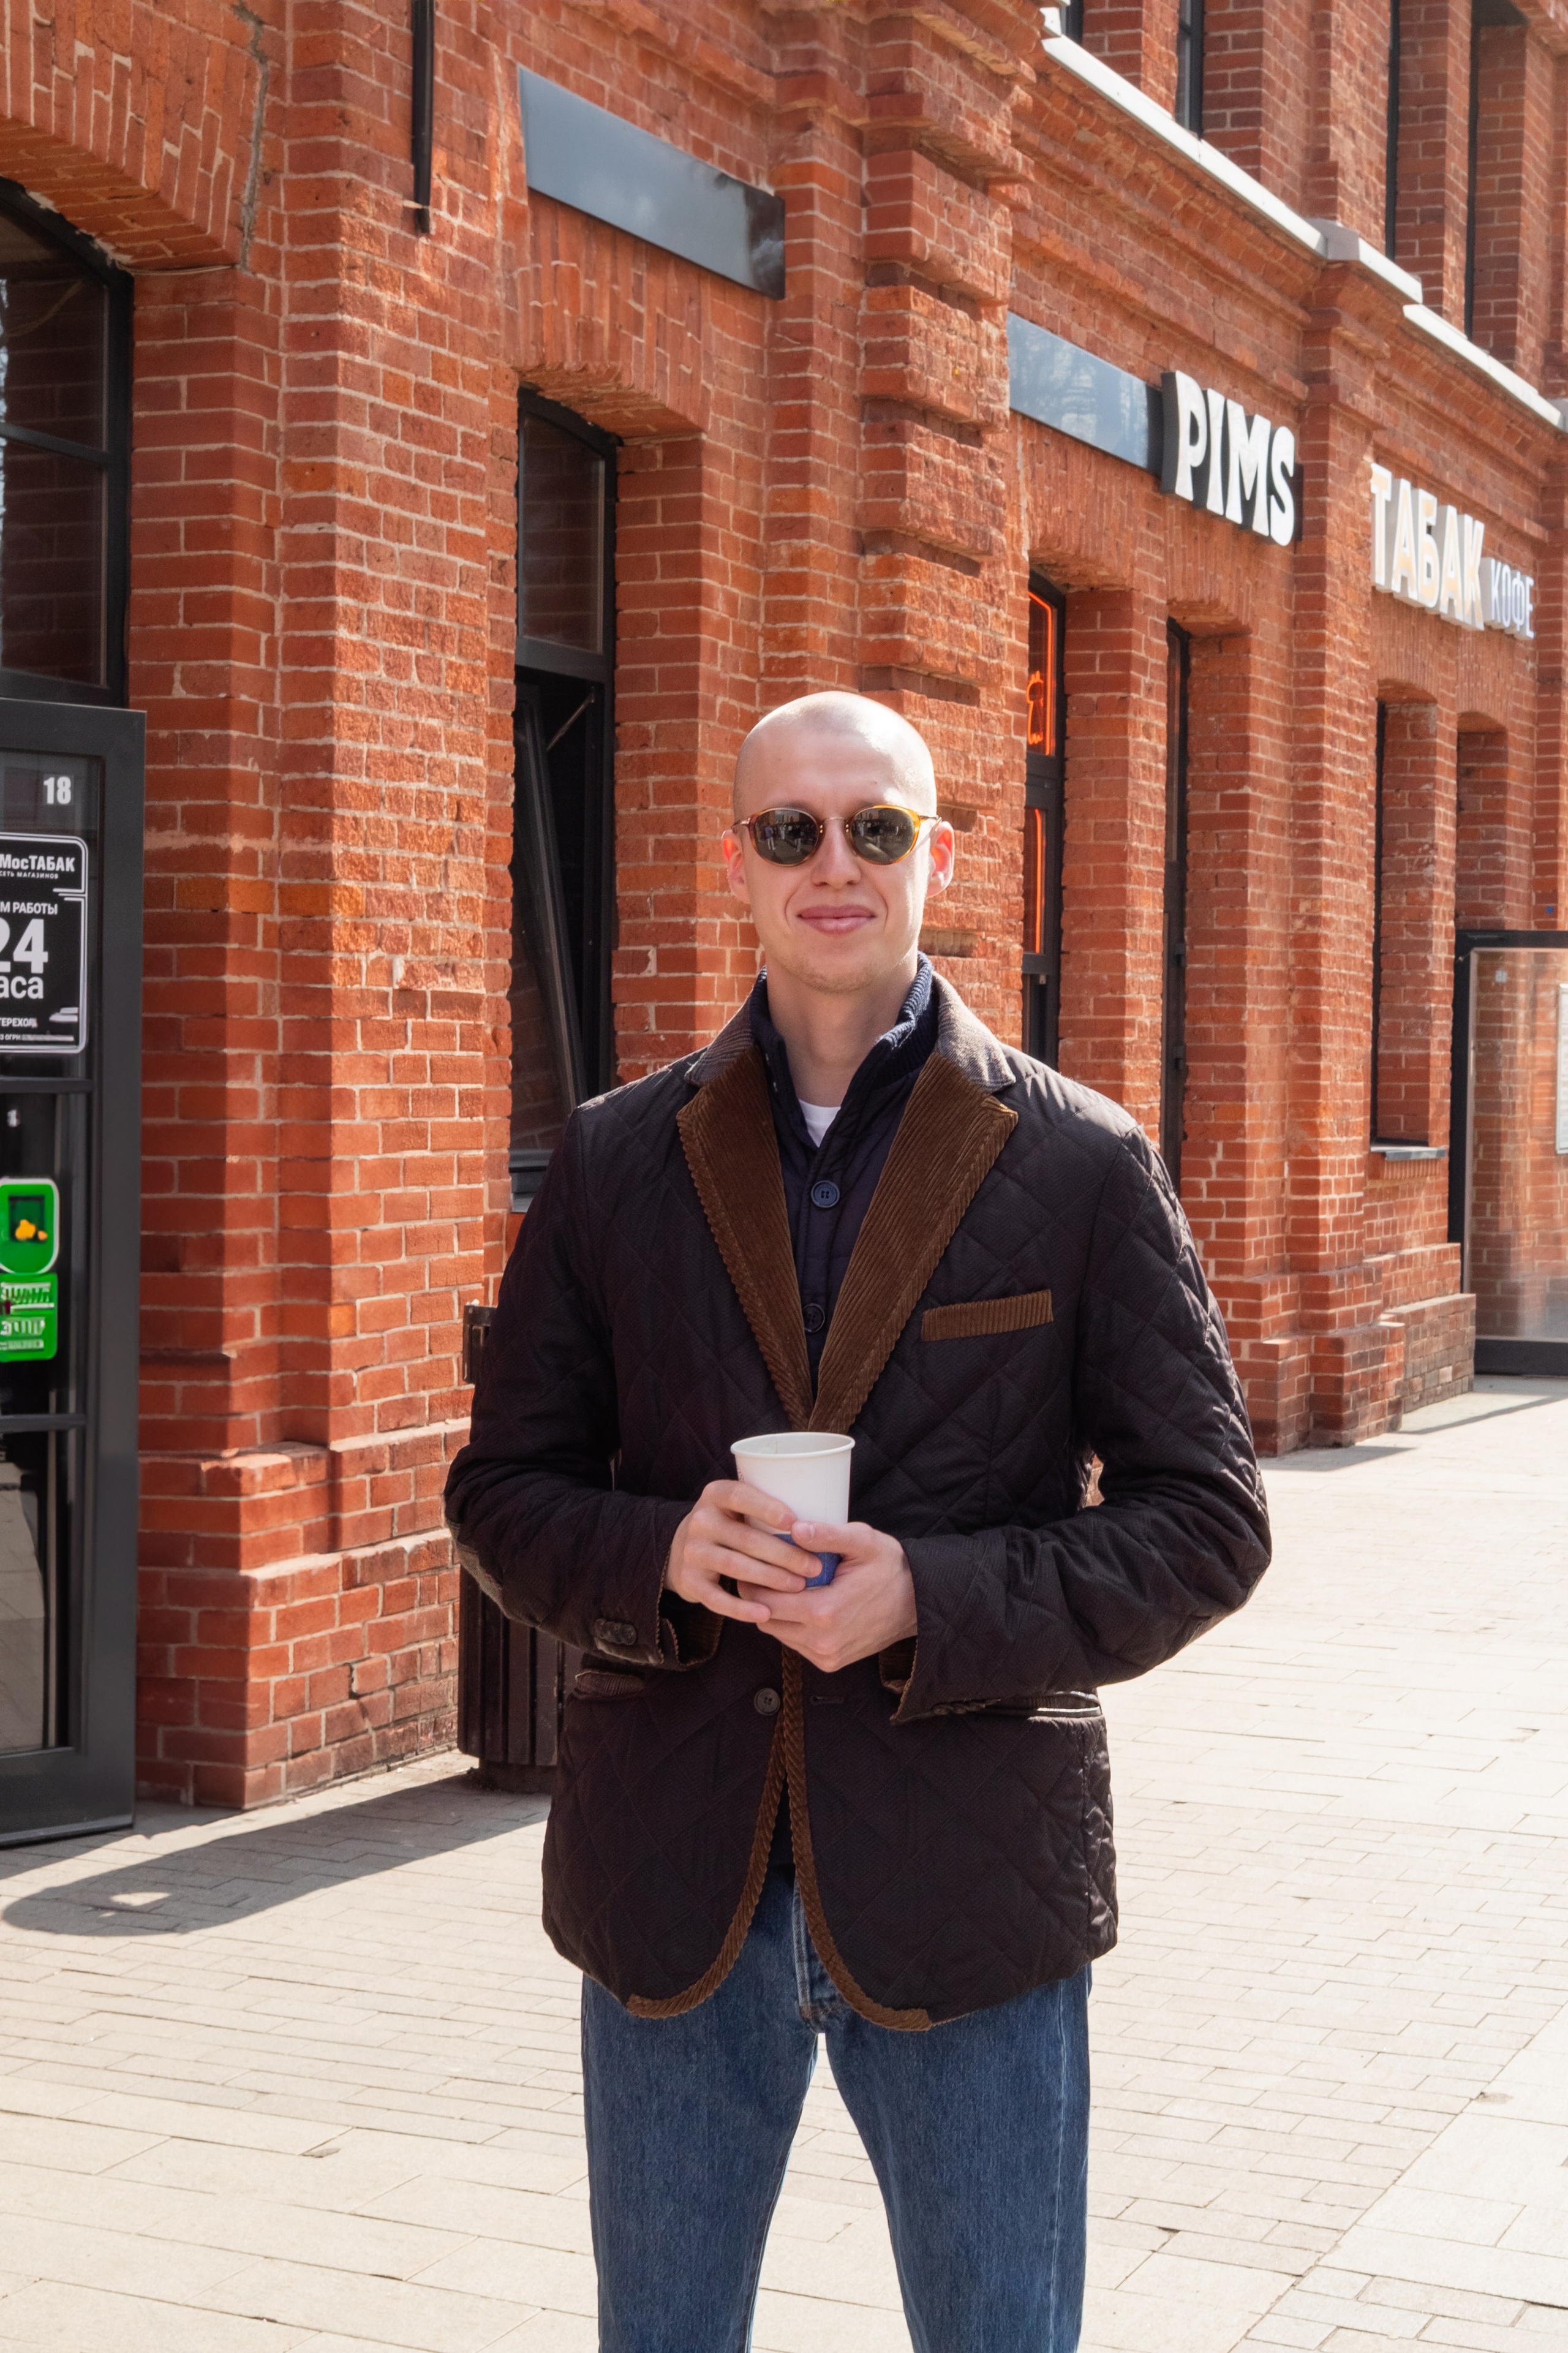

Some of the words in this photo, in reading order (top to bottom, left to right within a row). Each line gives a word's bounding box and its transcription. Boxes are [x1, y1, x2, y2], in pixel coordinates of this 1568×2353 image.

[1175, 369, 1295, 546] PIMS
[1370, 462, 1485, 631] ТАБАК
[1491, 557, 1535, 639] КОФЕ
[43, 776, 72, 805] 18
[0, 853, 75, 872] МосТАБАК
[17, 871, 59, 880] МАГАЗИНОВ
[12, 901, 58, 915] РАБОТЫ
